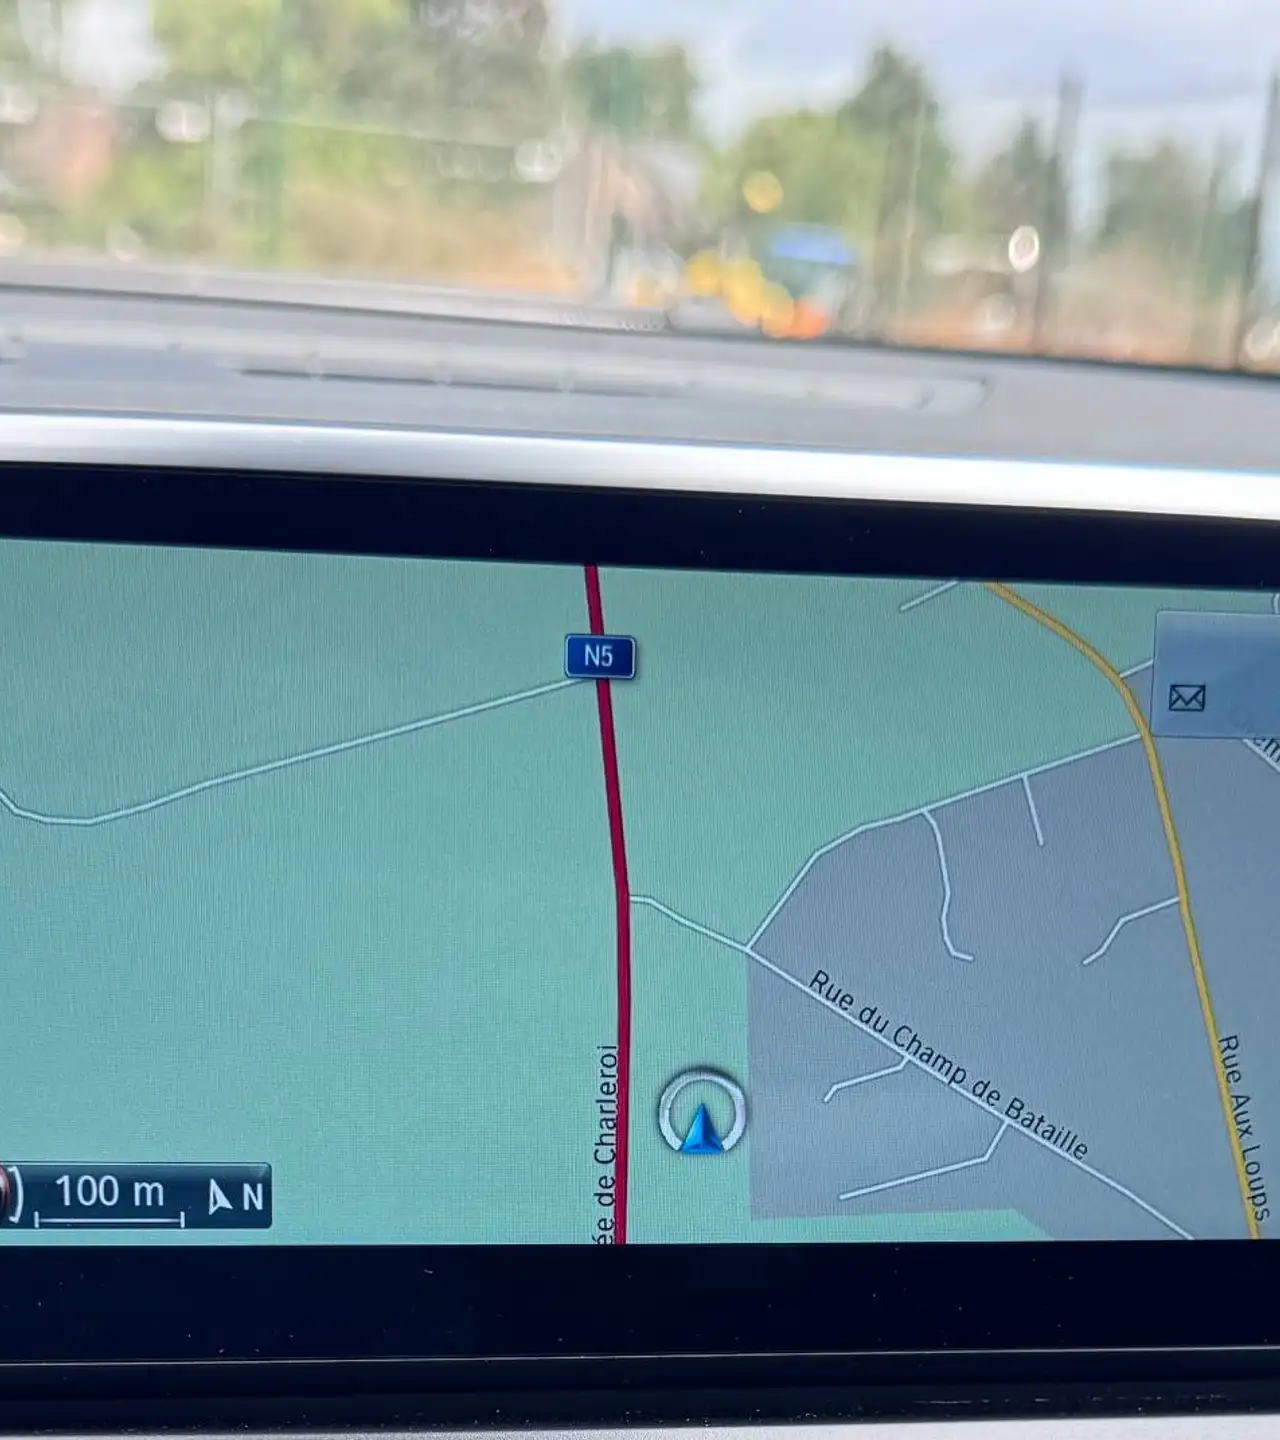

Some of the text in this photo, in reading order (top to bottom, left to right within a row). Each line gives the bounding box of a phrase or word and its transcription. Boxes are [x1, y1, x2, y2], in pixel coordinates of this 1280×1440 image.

[584, 644, 613, 667] N5
[808, 969, 1089, 1161] Rue du Champ de Bataille
[593, 1045, 618, 1165] Charleroi
[1218, 1034, 1271, 1222] Rue Aux Loups
[56, 1175, 164, 1206] 100 m
[243, 1183, 264, 1210] N
[593, 1174, 616, 1207] de
